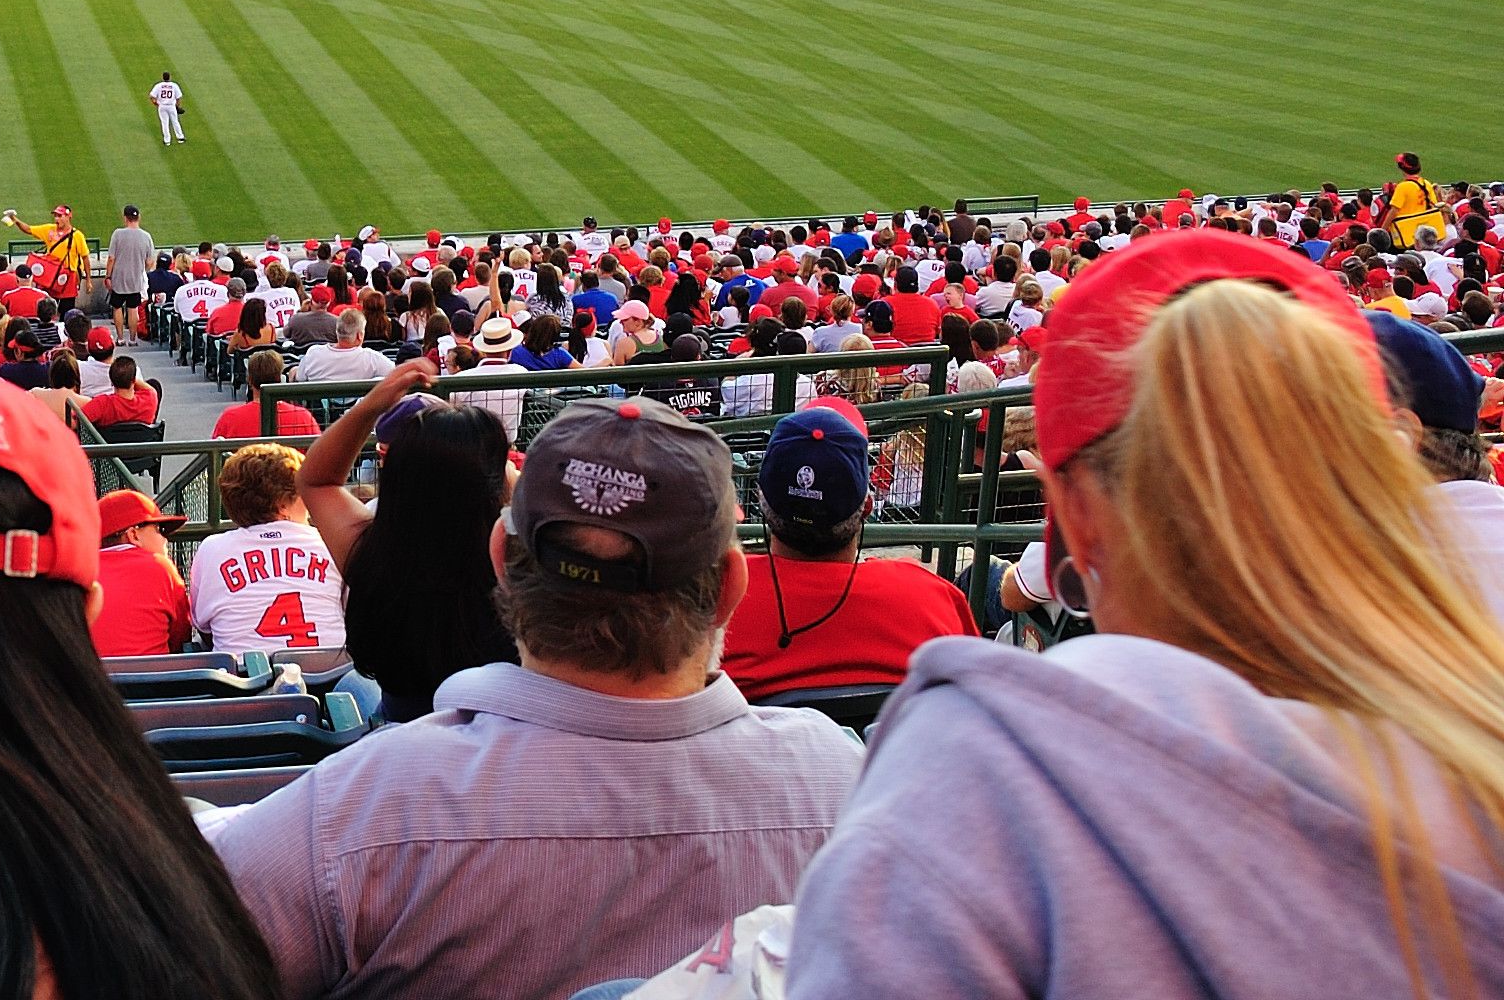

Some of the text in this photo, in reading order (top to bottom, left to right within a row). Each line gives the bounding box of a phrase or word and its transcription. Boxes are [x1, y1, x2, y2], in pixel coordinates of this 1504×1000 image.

[160, 90, 173, 99] 20
[186, 286, 217, 299] GRICH
[192, 299, 209, 318] 4
[276, 309, 295, 328] 17
[668, 390, 713, 411] FIGGINS
[565, 458, 648, 491] PECHANGA
[219, 546, 330, 593] GRICH
[559, 560, 601, 583] 1971
[254, 591, 320, 648] 4
